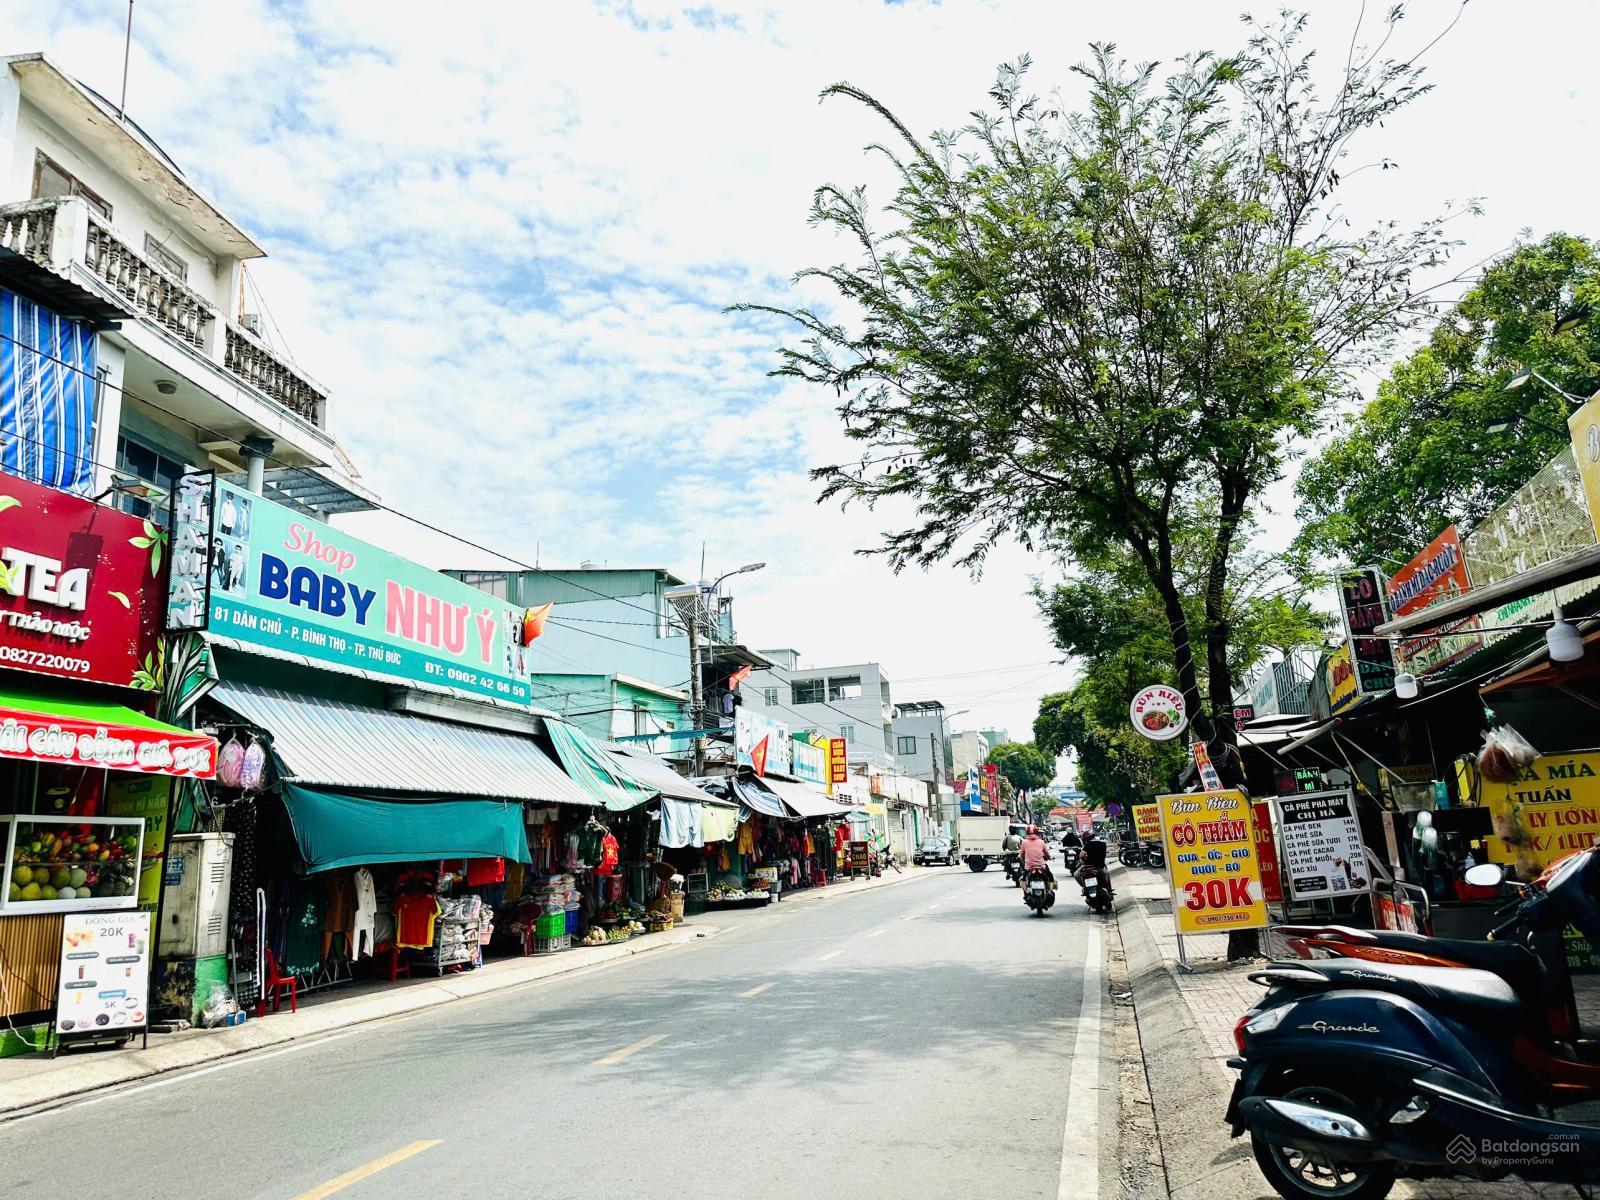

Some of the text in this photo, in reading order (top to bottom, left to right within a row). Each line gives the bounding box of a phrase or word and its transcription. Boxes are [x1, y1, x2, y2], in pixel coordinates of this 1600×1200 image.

[283, 522, 357, 574] Shop
[1, 547, 90, 611] TEA
[259, 553, 498, 665] BABY NHƯ Ý
[214, 606, 229, 621] 81
[232, 608, 258, 630] DÂN
[259, 615, 282, 635] CHỦ
[291, 627, 300, 640] P.
[302, 628, 328, 650] BÌNH
[328, 636, 347, 655] THỌ
[354, 642, 367, 656] TP.
[0, 646, 90, 673] 0827220079
[447, 667, 477, 686] 0902
[480, 678, 496, 691] 42
[497, 681, 511, 694] 66
[512, 685, 525, 698] 59
[1135, 691, 1154, 713] BÚN
[1547, 759, 1597, 780] MÍA
[1170, 796, 1239, 815] Bún Riêu
[1284, 803, 1295, 812] CÀ
[1296, 801, 1310, 810] PHÊ
[1312, 800, 1327, 808] PHA
[1297, 808, 1336, 820] CHỊ HÀ
[1172, 818, 1197, 847] CÔ
[1177, 852, 1199, 862] CUA
[1183, 876, 1255, 911] 30K
[100, 927, 124, 937] 20K
[1340, 969, 1398, 982] Grande
[1297, 1020, 1380, 1034] Grande
